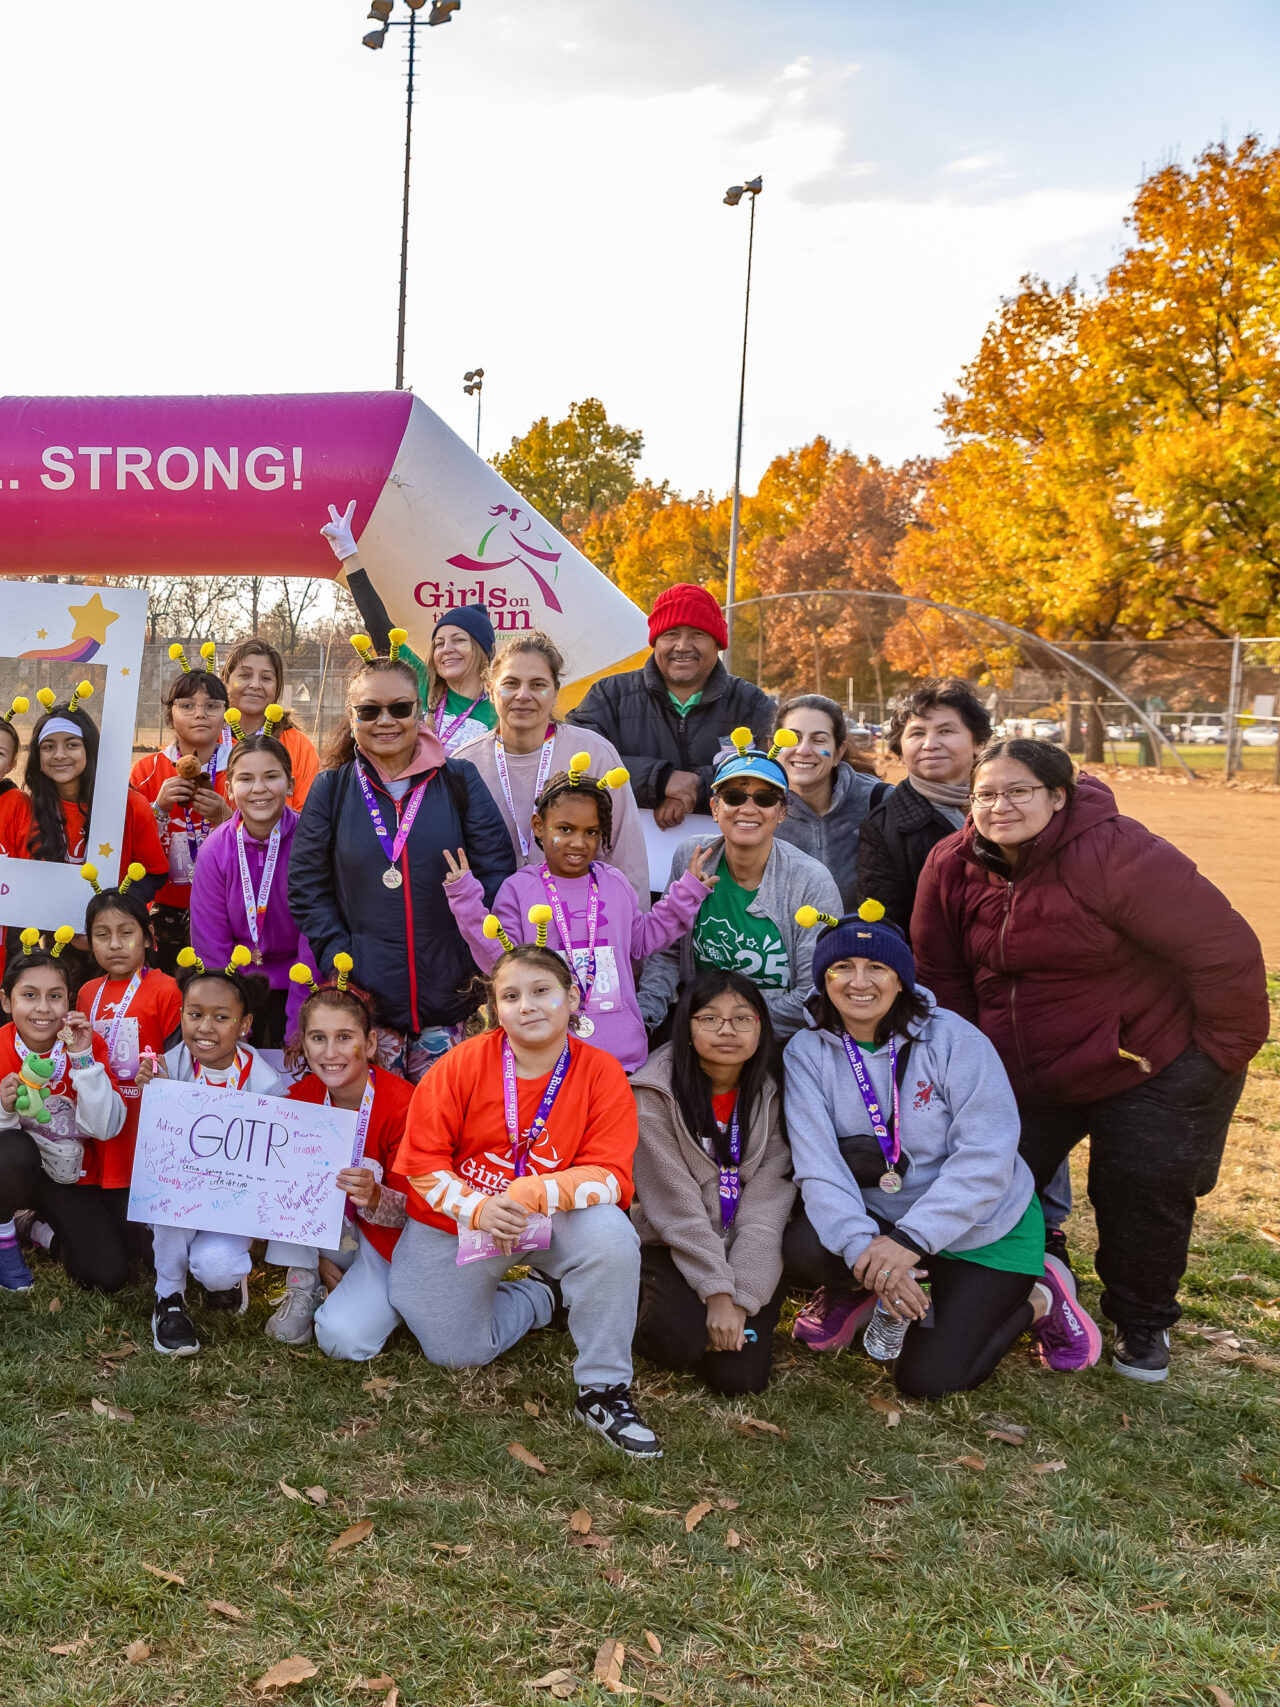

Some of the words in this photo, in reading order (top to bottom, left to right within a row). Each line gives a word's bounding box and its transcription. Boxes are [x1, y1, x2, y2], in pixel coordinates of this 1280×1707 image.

[40, 446, 303, 491] STRONG!
[414, 580, 507, 608] Girls
[509, 597, 530, 607] on
[493, 608, 534, 630] un
[542, 749, 552, 770] Girls
[360, 776, 370, 793] Run
[405, 800, 420, 820] Girls
[260, 881, 270, 901] Girls
[268, 845, 277, 862] Run
[243, 876, 251, 894] Run
[588, 904, 597, 921] Run
[734, 949, 790, 988] 25
[116, 1002, 128, 1019] Run
[505, 1058, 515, 1079] Run
[554, 1063, 564, 1076] the
[848, 1050, 857, 1063] the
[853, 1061, 865, 1083] Run
[507, 1079, 515, 1093] the
[546, 1075, 562, 1096] Run
[508, 1091, 515, 1103] on
[156, 1117, 184, 1136] Adira
[507, 1103, 517, 1129] Girls
[357, 1118, 367, 1137] Run
[731, 1124, 740, 1144] Run
[189, 1114, 288, 1168] GOTR
[460, 1157, 513, 1192] Girls
